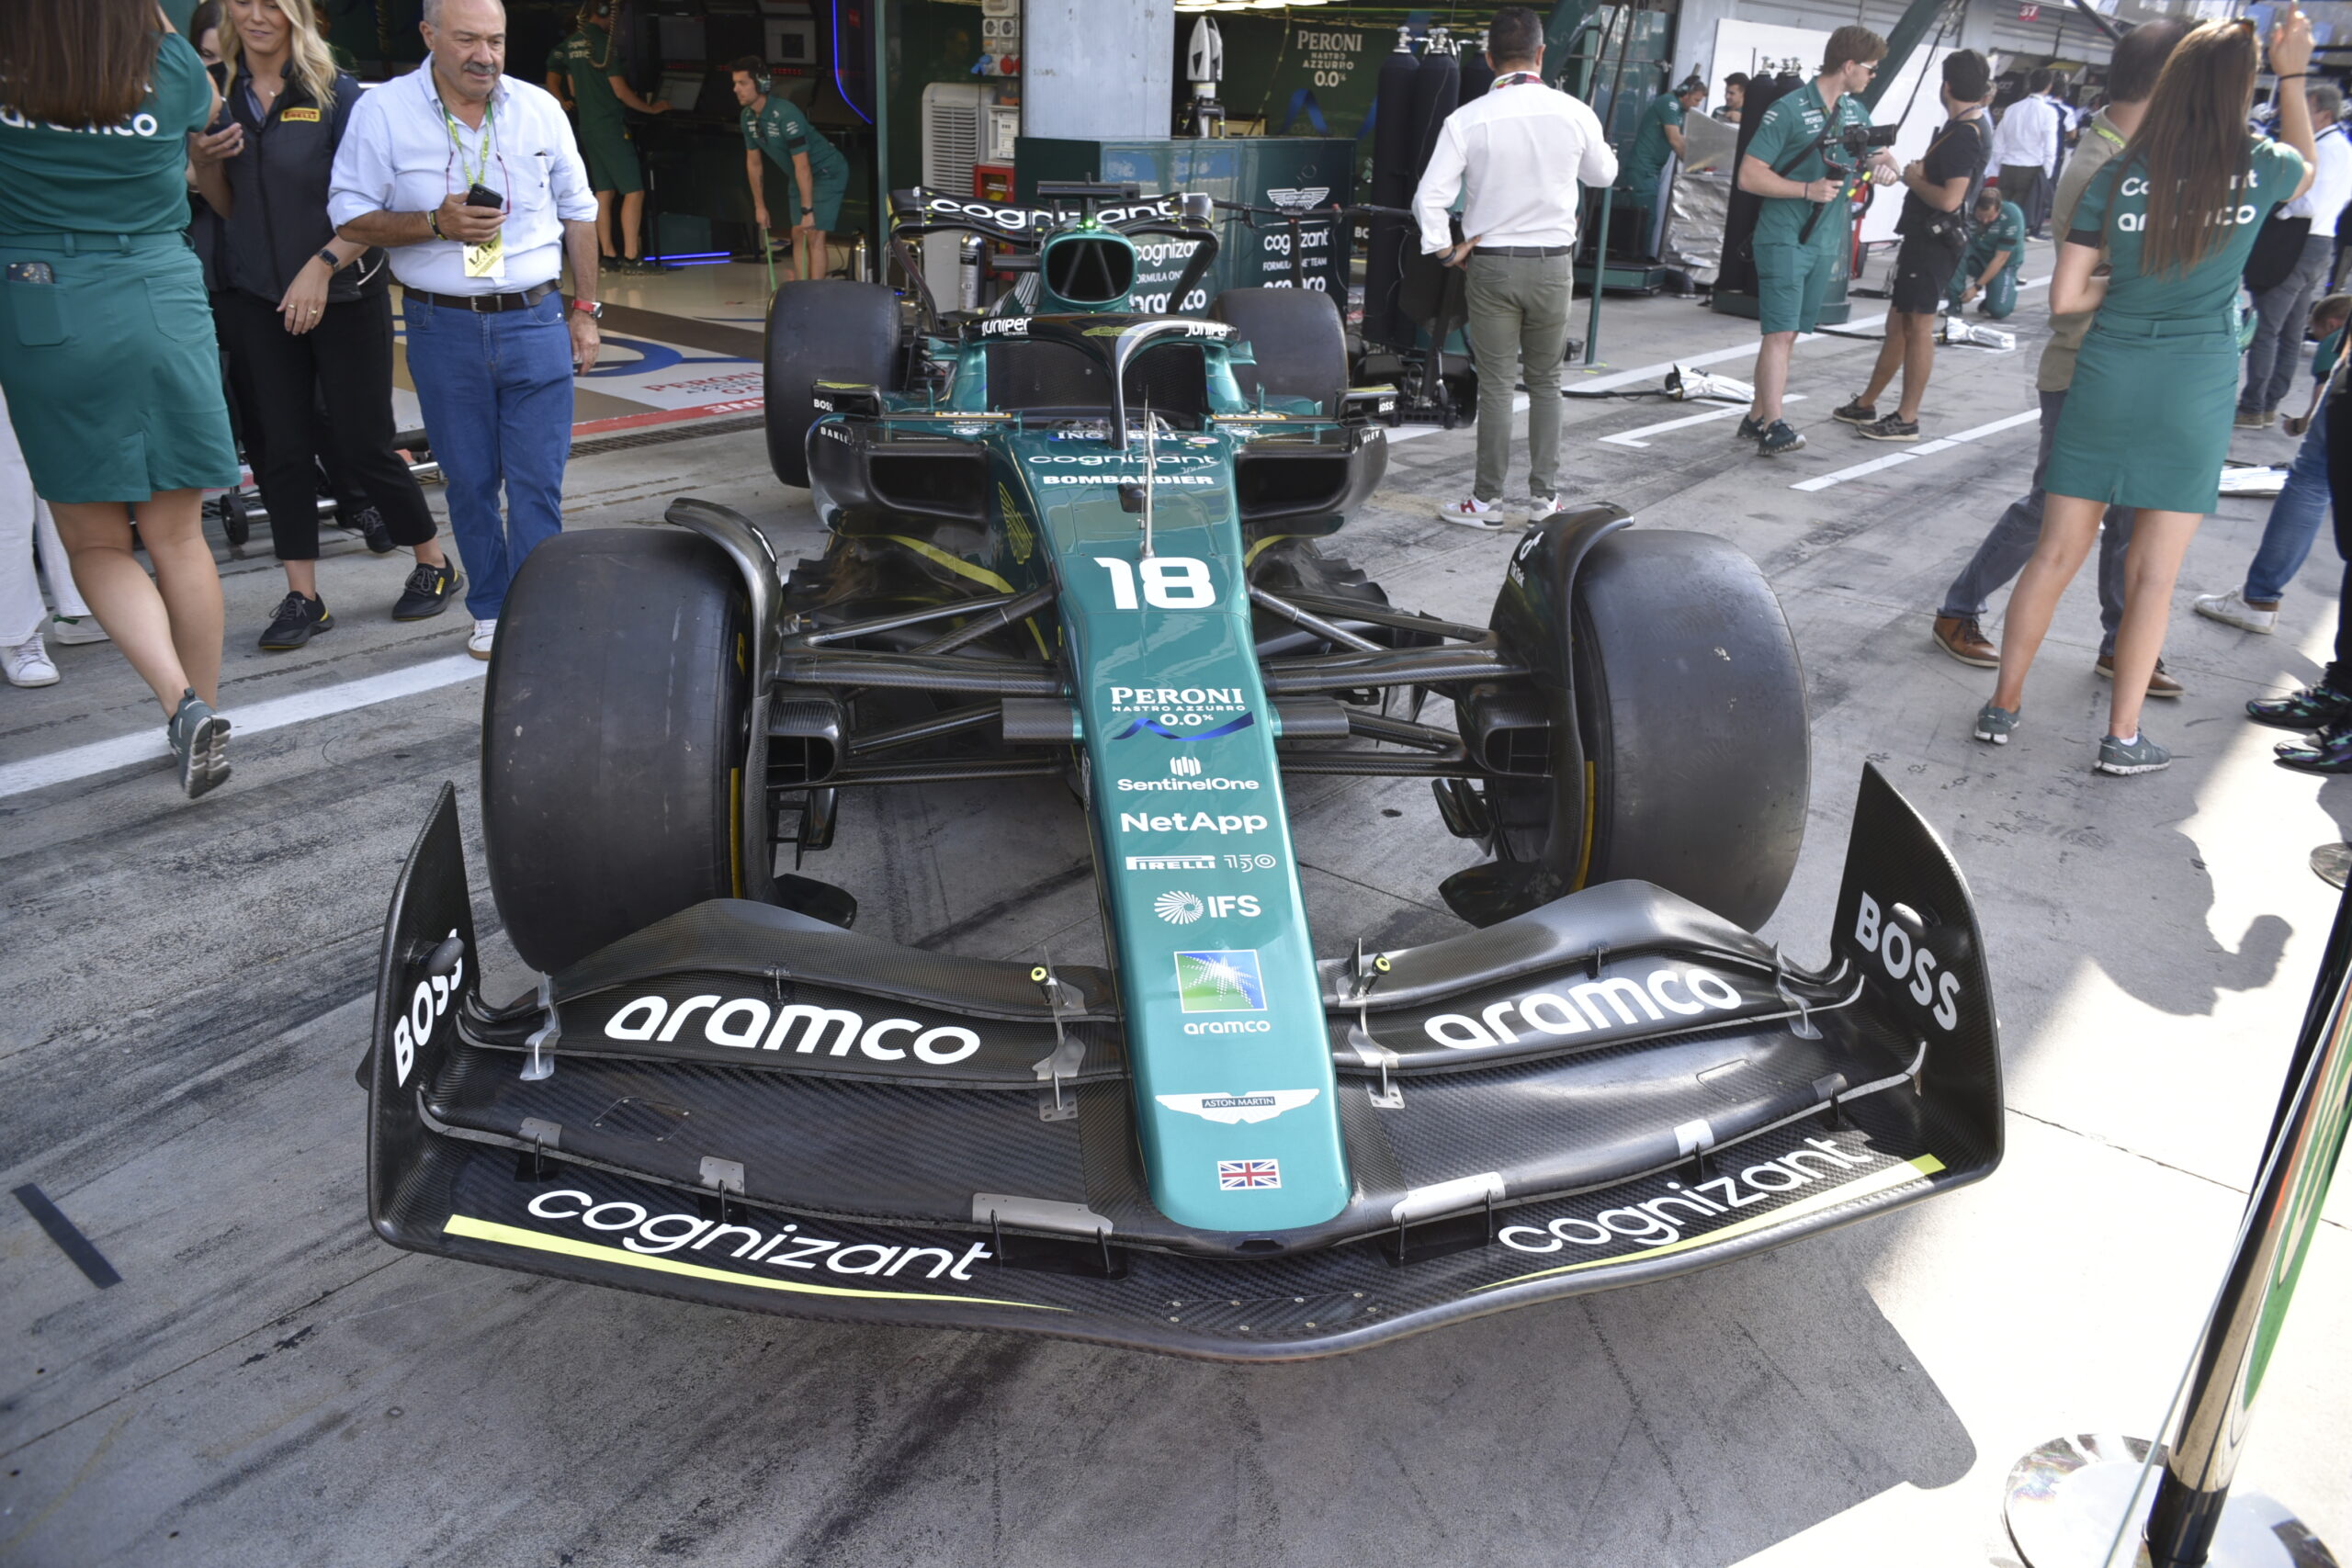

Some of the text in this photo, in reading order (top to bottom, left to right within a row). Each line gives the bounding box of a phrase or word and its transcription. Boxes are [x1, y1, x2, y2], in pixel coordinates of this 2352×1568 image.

[1297, 30, 1363, 51] PERONI
[1264, 230, 1329, 255] cogzant
[1029, 455, 1217, 466] cognizant
[1043, 475, 1214, 484] BOMBARDIER
[1092, 557, 1216, 610] 18
[1110, 687, 1244, 705] PERONI
[1159, 713, 1214, 727] 0.0%
[1117, 778, 1260, 791] SentinelOne
[1120, 812, 1268, 834] NetApp
[1125, 853, 1276, 873] PIRELLI 150
[1207, 895, 1261, 918] IFS
[1854, 891, 1964, 1031] BOSS
[1424, 967, 1741, 1049] aramco
[605, 995, 981, 1065] aramco
[1183, 1021, 1271, 1034] aramco
[1204, 1098, 1274, 1108] ASTON MARTIN
[1498, 1137, 1873, 1253] cognizant
[527, 1190, 993, 1280] cognizant
